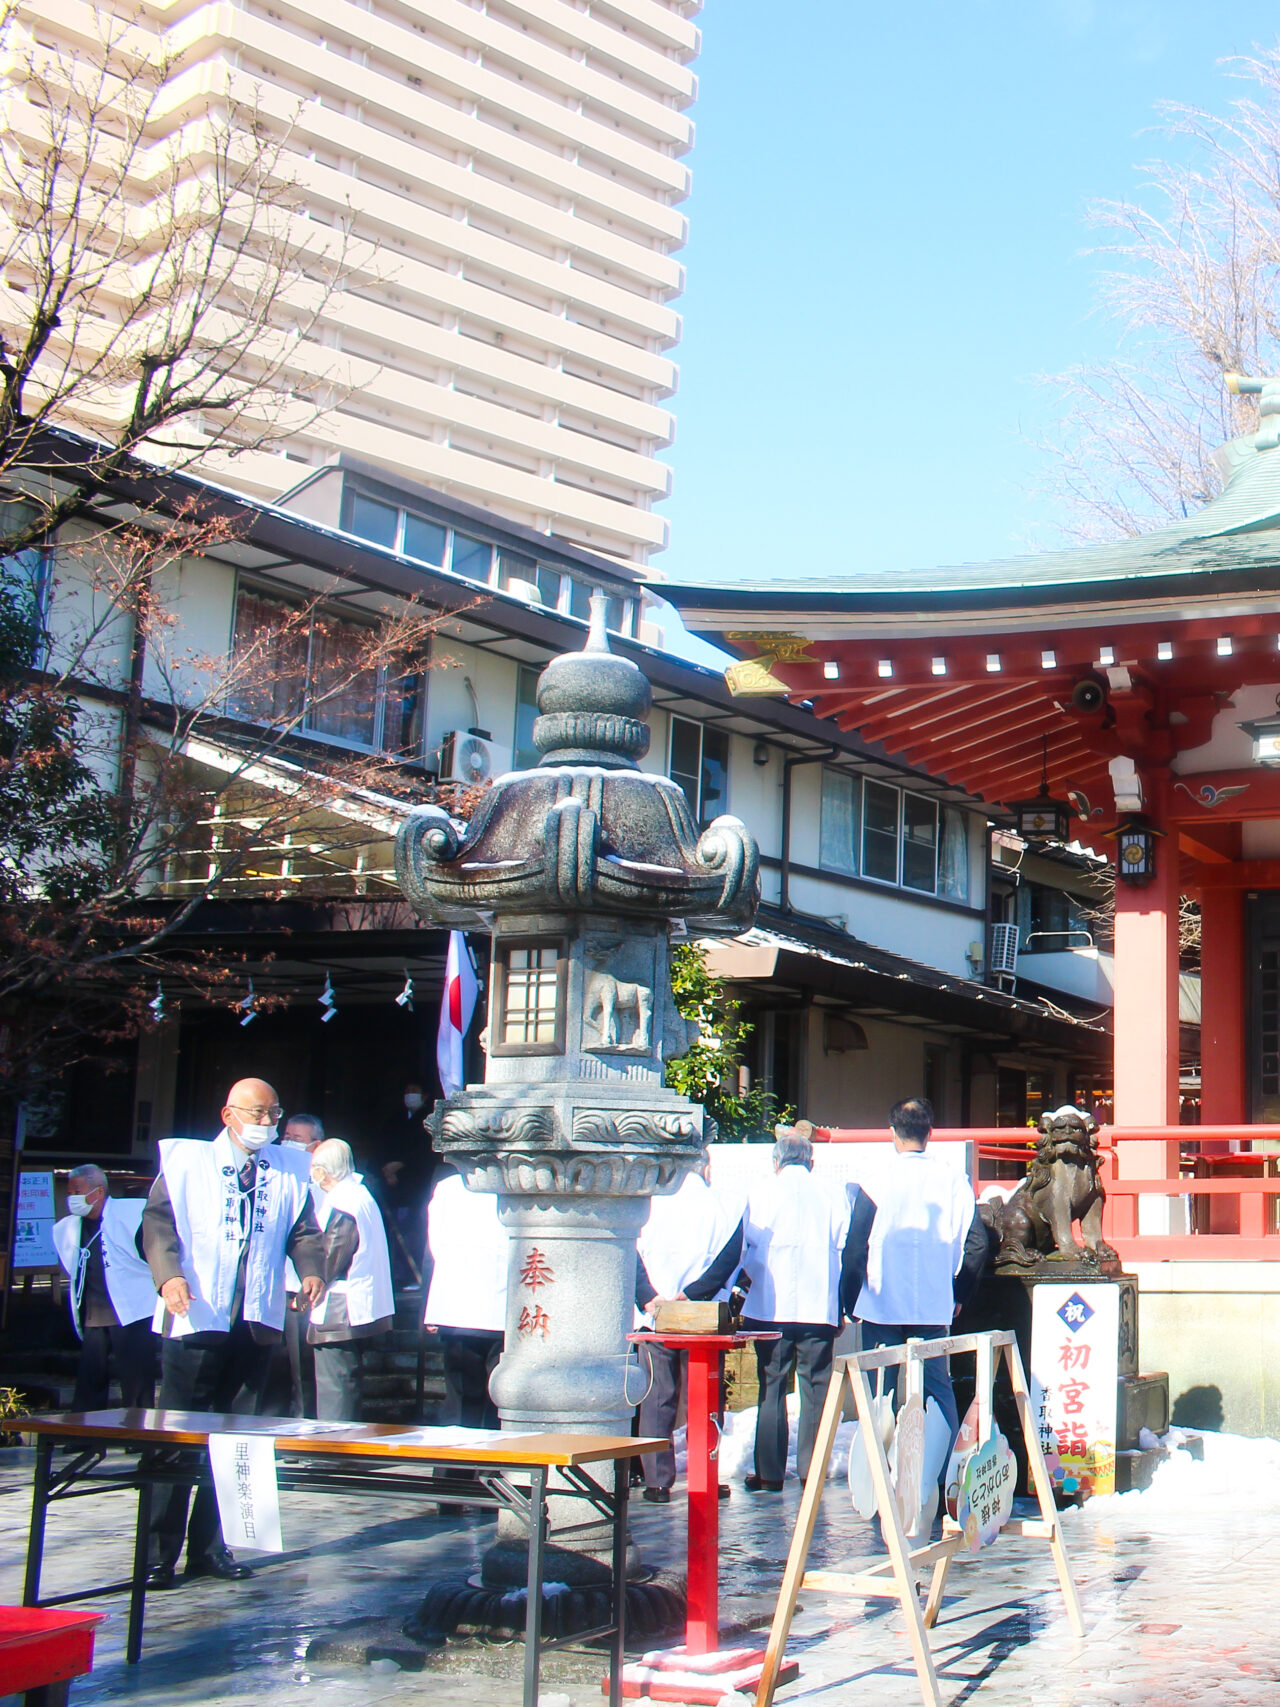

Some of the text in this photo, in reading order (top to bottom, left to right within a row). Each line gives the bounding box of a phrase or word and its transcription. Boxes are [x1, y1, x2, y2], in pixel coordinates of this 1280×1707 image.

[517, 1247, 556, 1343] 奉納
[1064, 1301, 1086, 1323] 祝
[1038, 1386, 1053, 1456] 香取神社
[1054, 1336, 1092, 1458] 初宮詣
[234, 1442, 256, 1539] 里神楽演目
